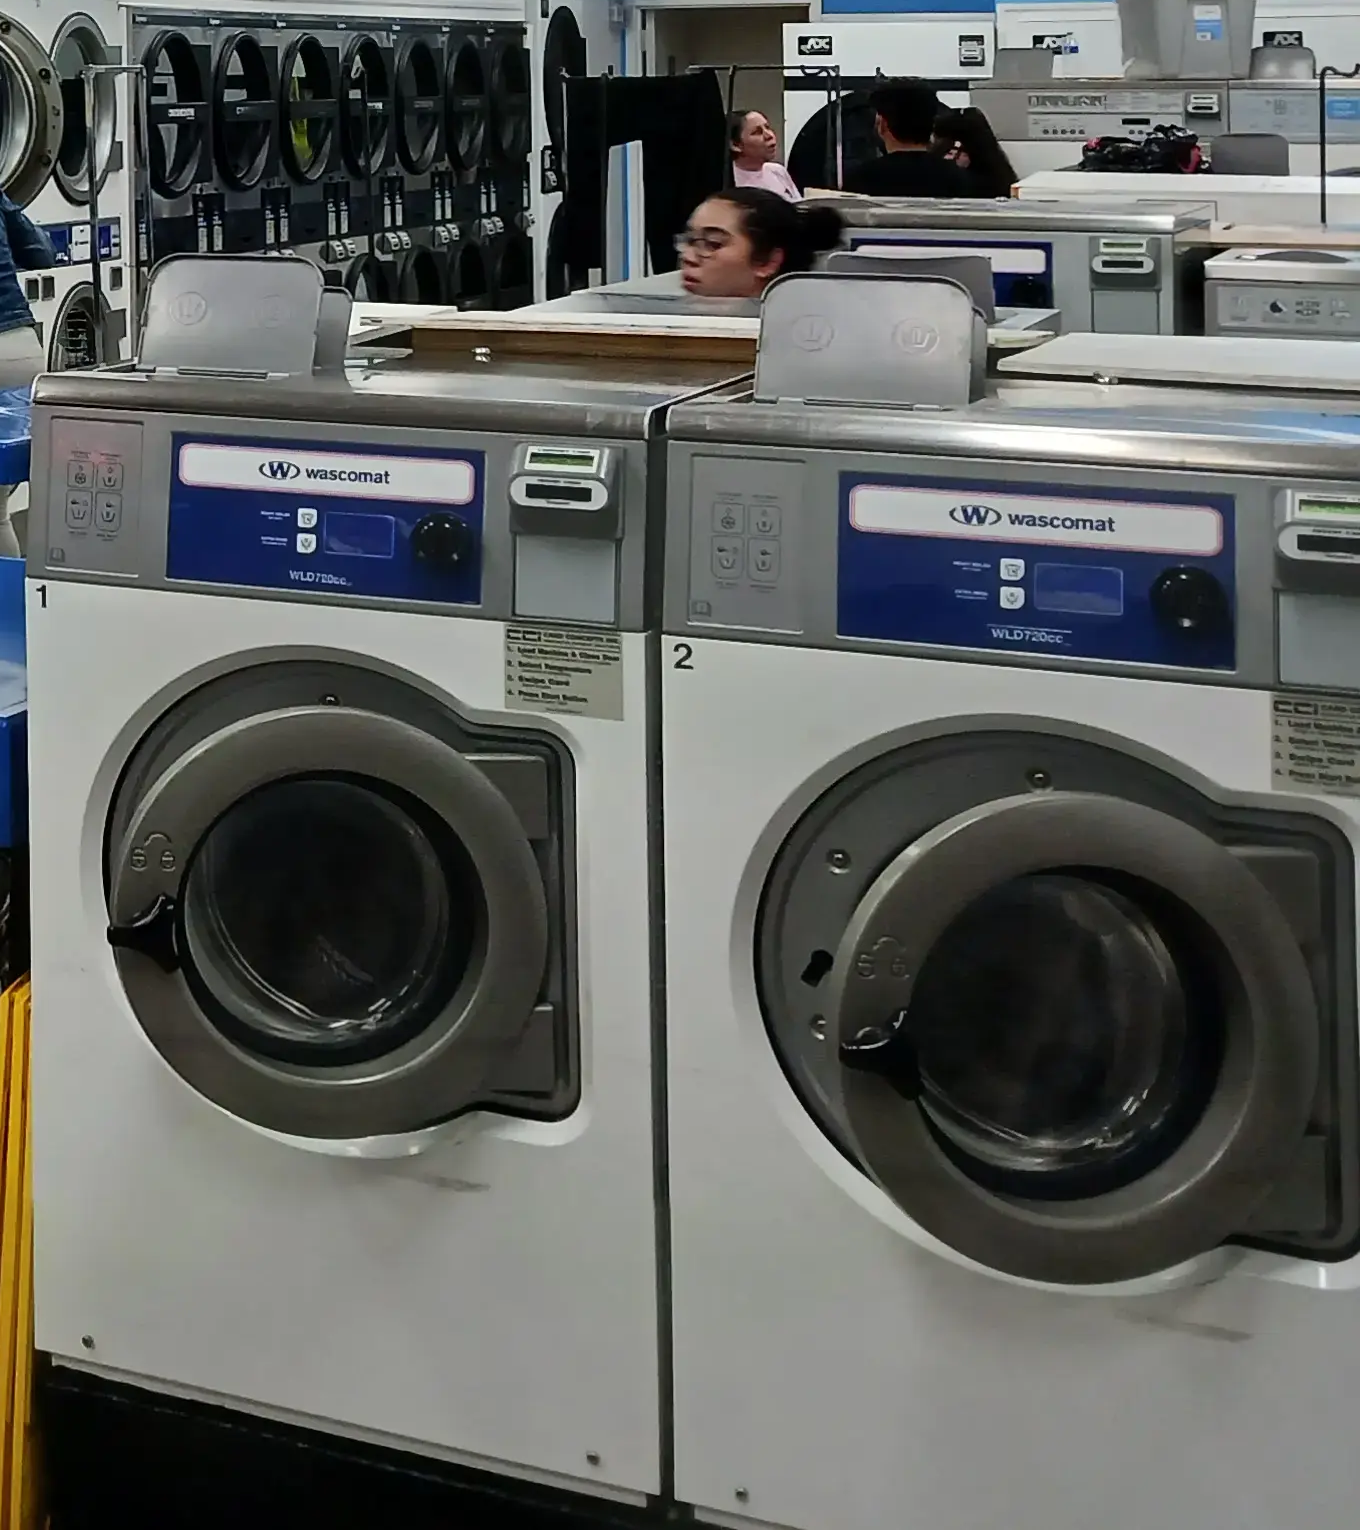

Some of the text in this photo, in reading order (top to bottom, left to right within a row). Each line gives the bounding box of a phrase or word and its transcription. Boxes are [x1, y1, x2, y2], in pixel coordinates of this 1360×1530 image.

[305, 466, 391, 485] wascomat
[1007, 513, 1116, 533] wascomat
[35, 584, 47, 609] 1
[672, 642, 695, 671] 2
